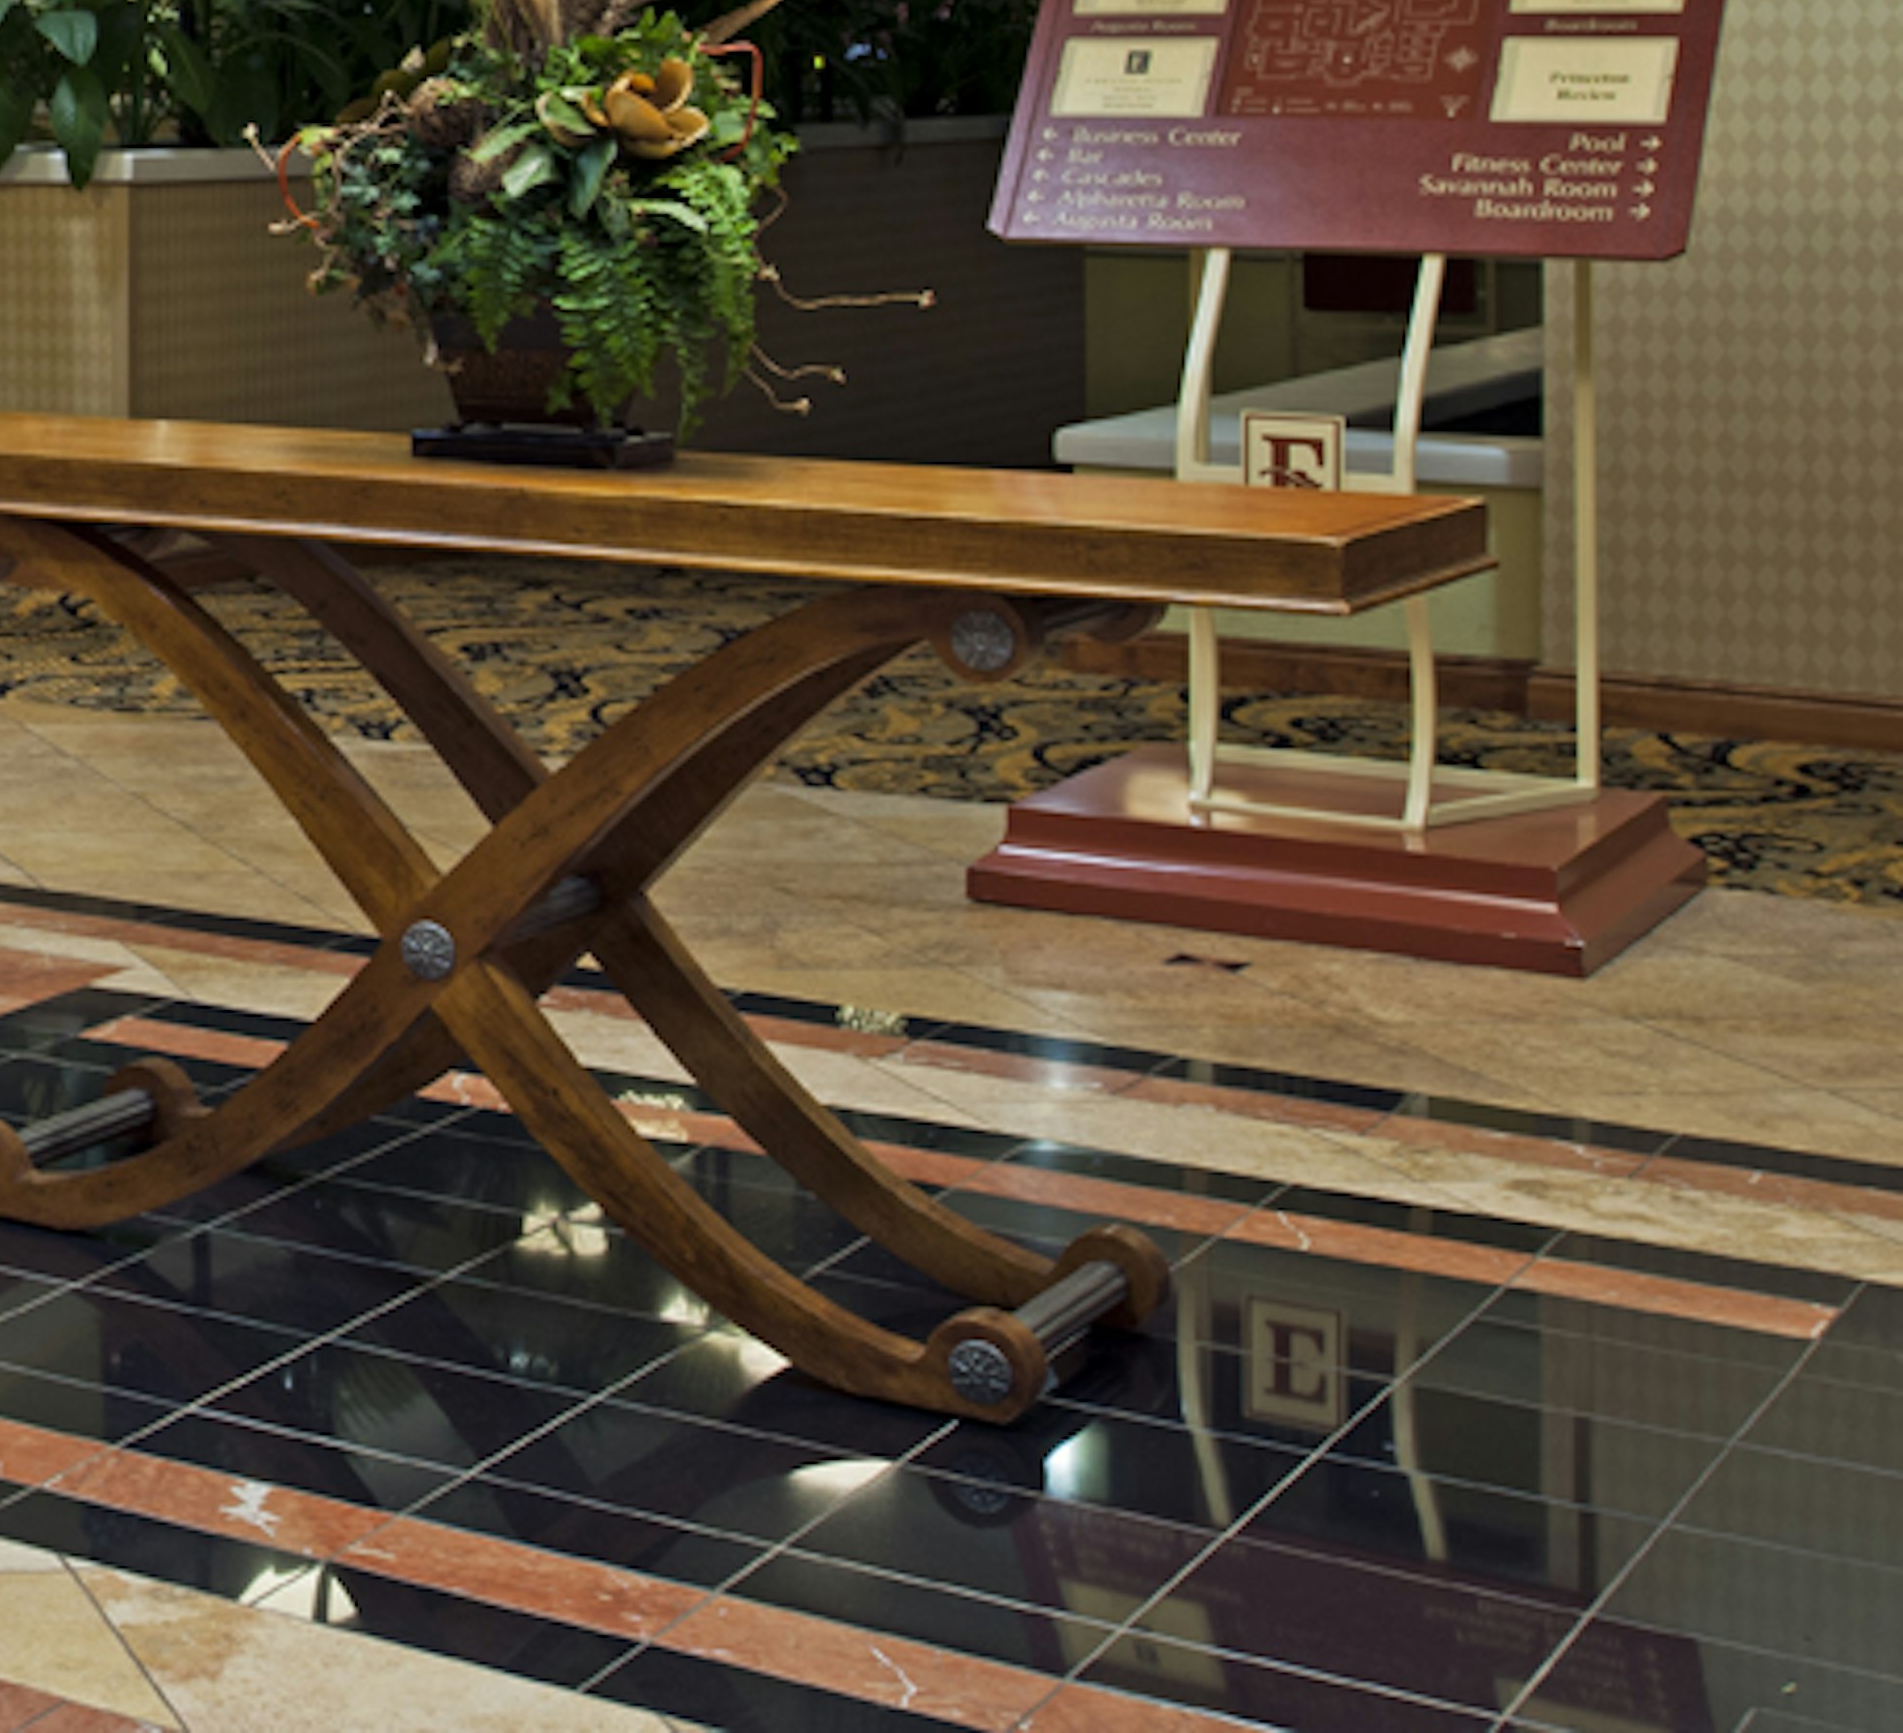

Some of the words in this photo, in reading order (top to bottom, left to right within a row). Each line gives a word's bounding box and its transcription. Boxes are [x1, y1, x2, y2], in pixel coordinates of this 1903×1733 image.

[1071, 126, 1159, 145] Business
[1168, 127, 1243, 147] Center
[1568, 133, 1629, 152] Pool
[1068, 148, 1104, 164] Bar
[1451, 152, 1531, 174] Fitness
[1539, 154, 1624, 176] Center
[1061, 170, 1164, 187] Cascades
[1418, 174, 1534, 196] Savannah
[1543, 178, 1618, 198] Room
[1057, 189, 1169, 210] Alpharetta
[1177, 191, 1247, 210] Room
[1473, 198, 1614, 222] Boardroom
[1052, 211, 1139, 230] Augusta
[1147, 213, 1215, 231] Room
